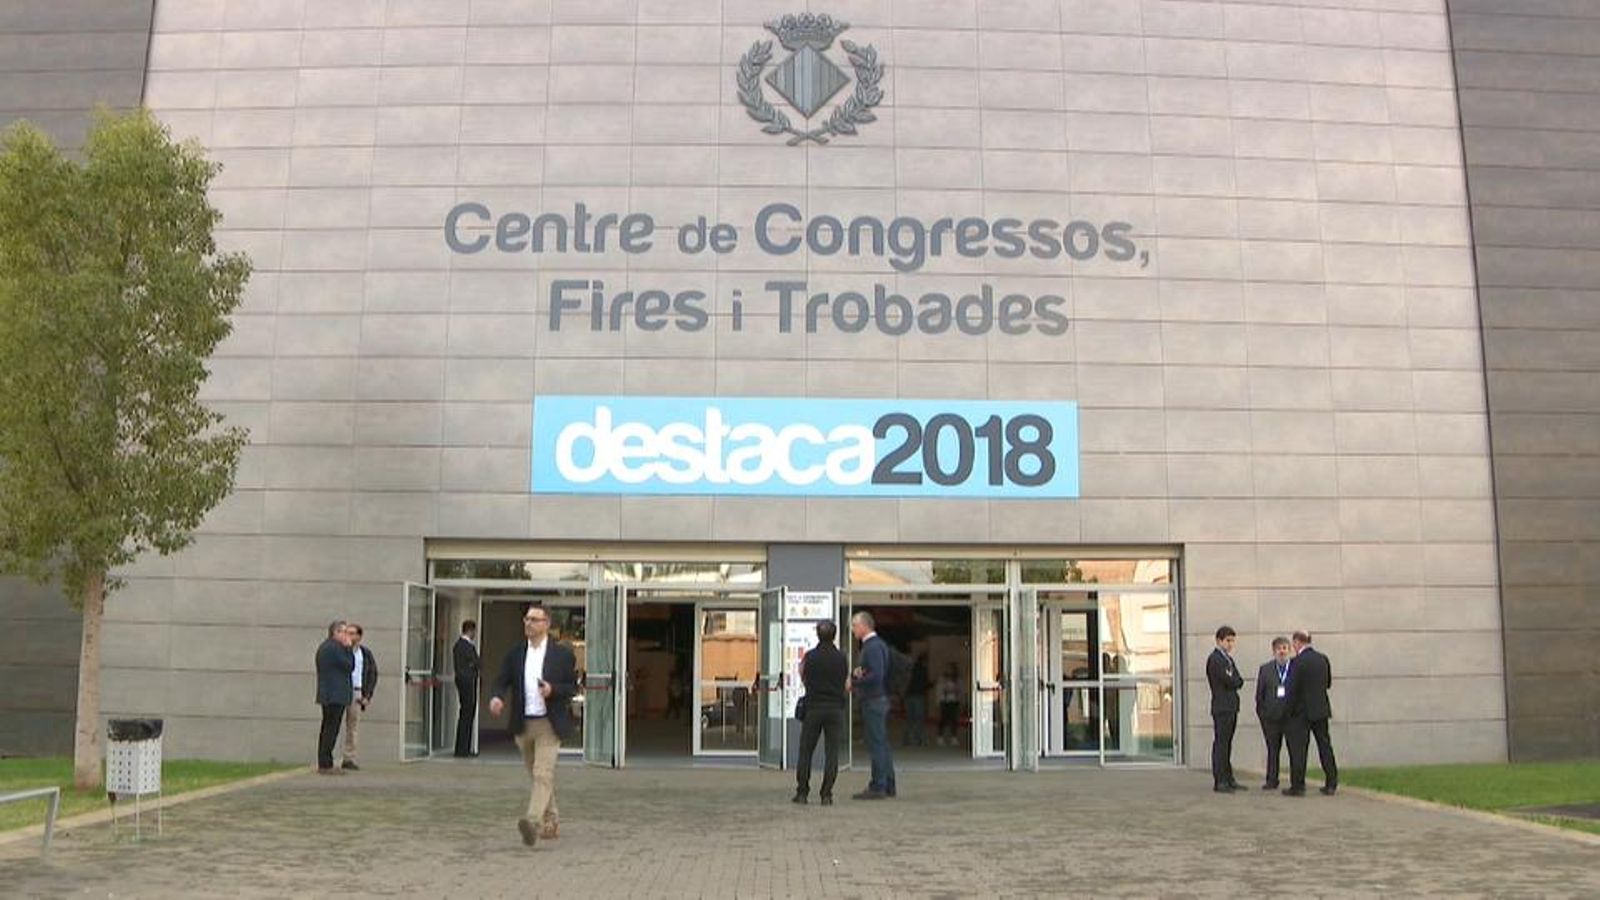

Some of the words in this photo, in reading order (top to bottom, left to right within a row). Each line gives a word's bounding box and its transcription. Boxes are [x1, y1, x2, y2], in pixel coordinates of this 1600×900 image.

[444, 202, 654, 254] Centre
[677, 215, 738, 254] de
[754, 203, 1150, 272] Congressos,
[549, 279, 709, 332] Fires
[731, 288, 743, 332] i
[764, 280, 1069, 336] Trobades
